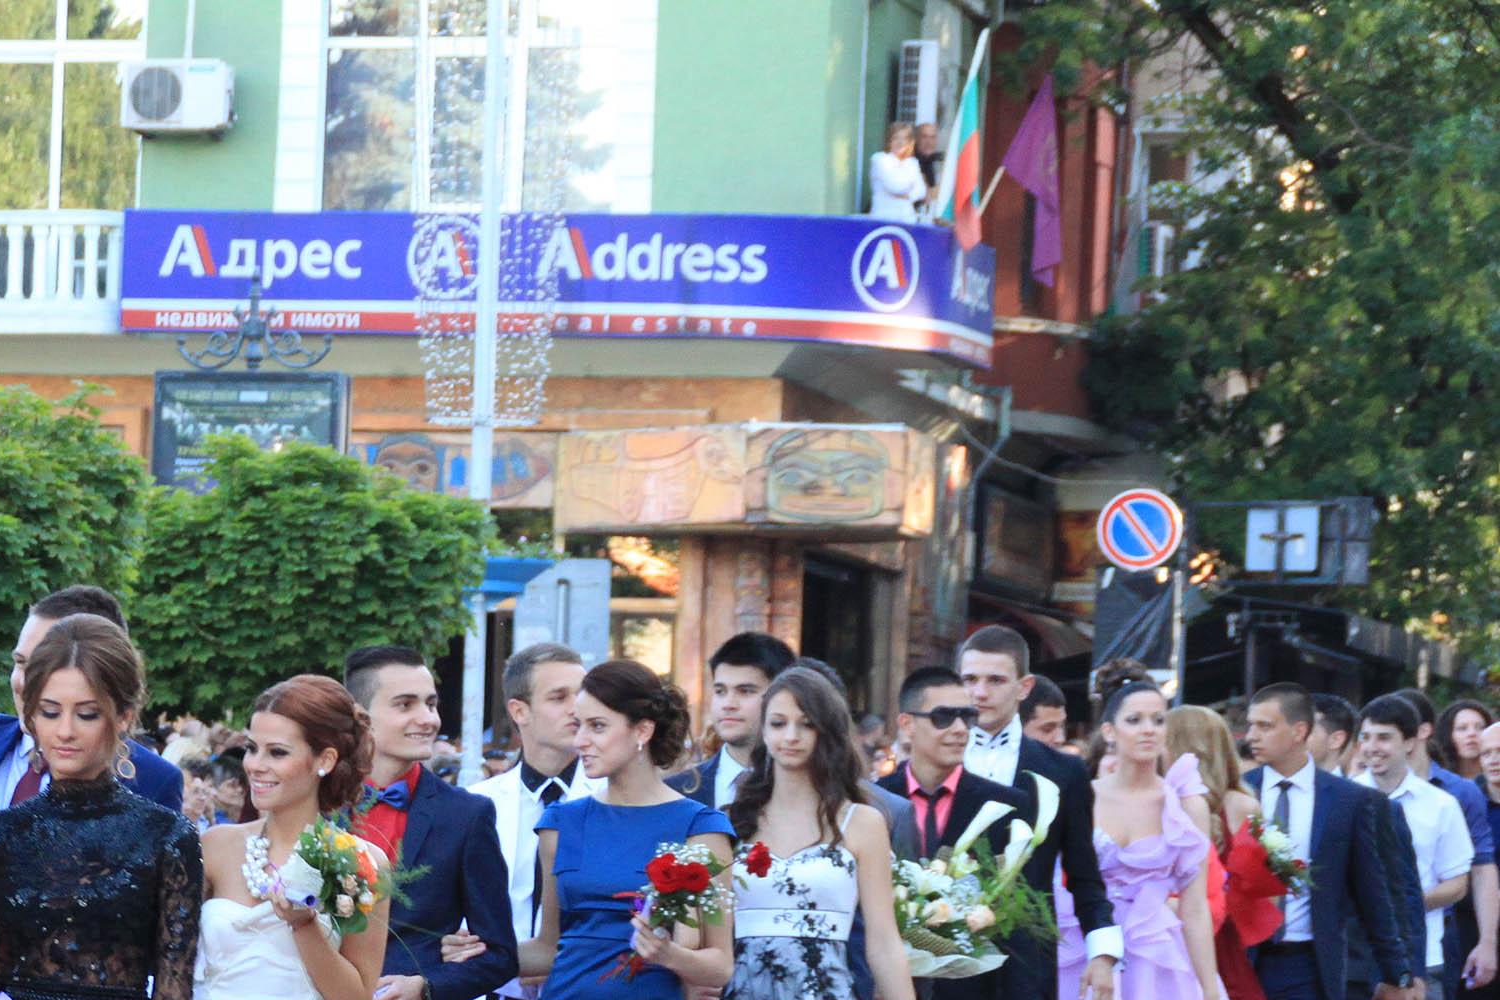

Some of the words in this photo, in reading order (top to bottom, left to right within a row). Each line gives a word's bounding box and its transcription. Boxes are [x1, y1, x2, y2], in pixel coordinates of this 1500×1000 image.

[158, 224, 363, 290] Адрес
[535, 226, 769, 283] Address
[291, 312, 361, 328] имоти
